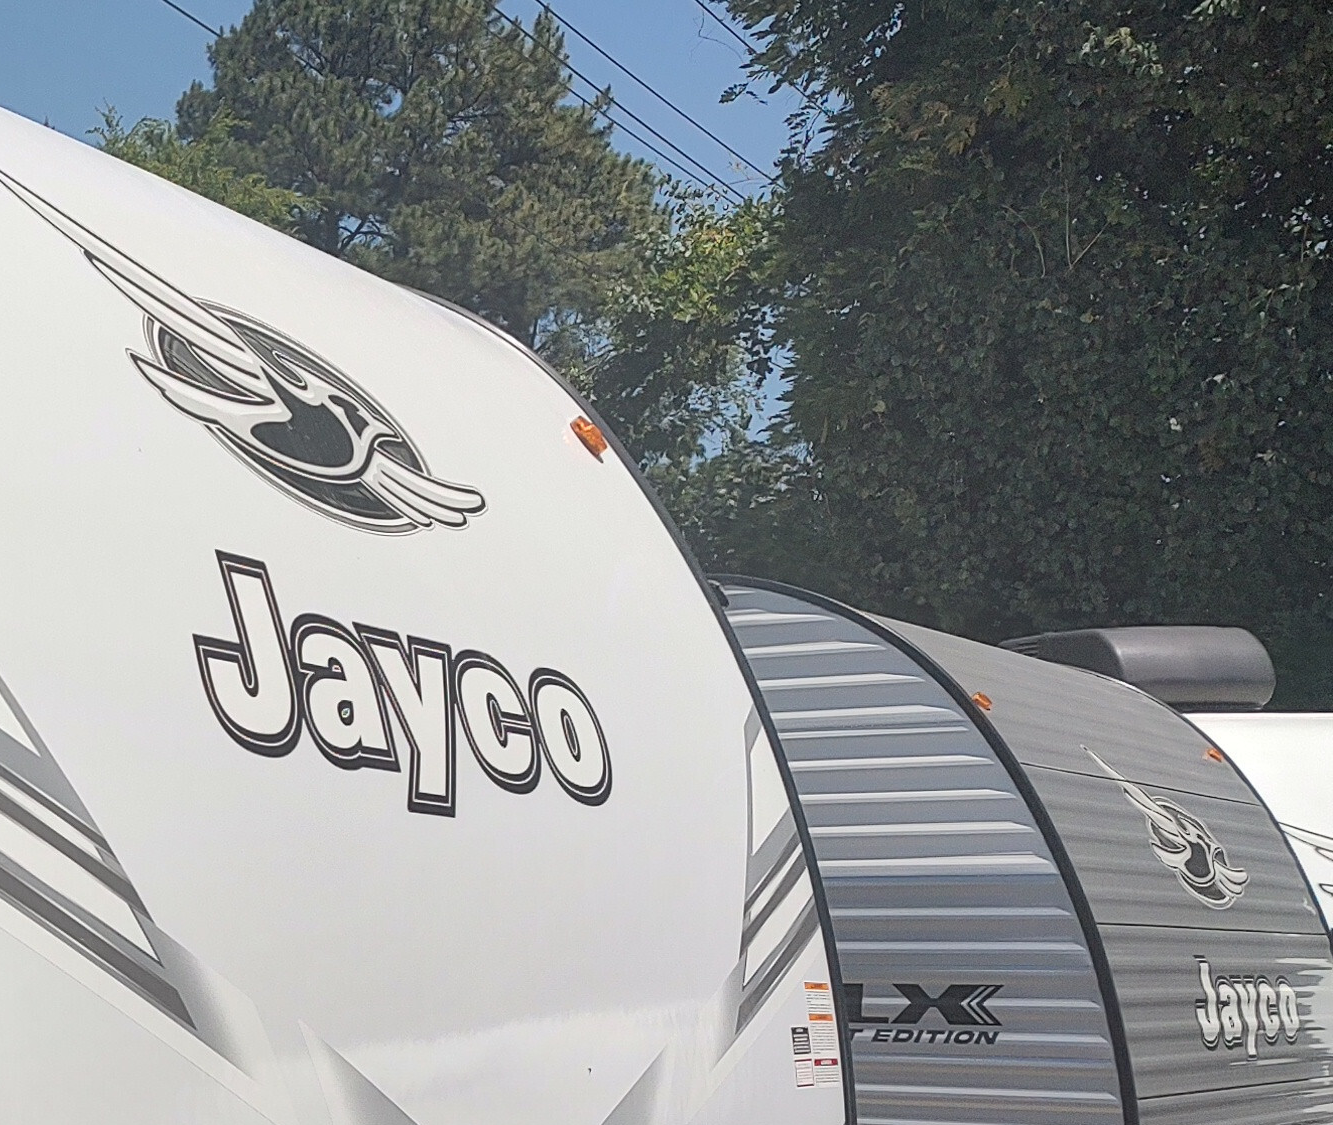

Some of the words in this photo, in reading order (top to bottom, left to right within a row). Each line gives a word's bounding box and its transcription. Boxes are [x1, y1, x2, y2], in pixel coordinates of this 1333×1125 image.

[193, 549, 612, 818] Jayco
[871, 1029, 1000, 1045] EDITION
[1193, 955, 1300, 1061] Jayco
